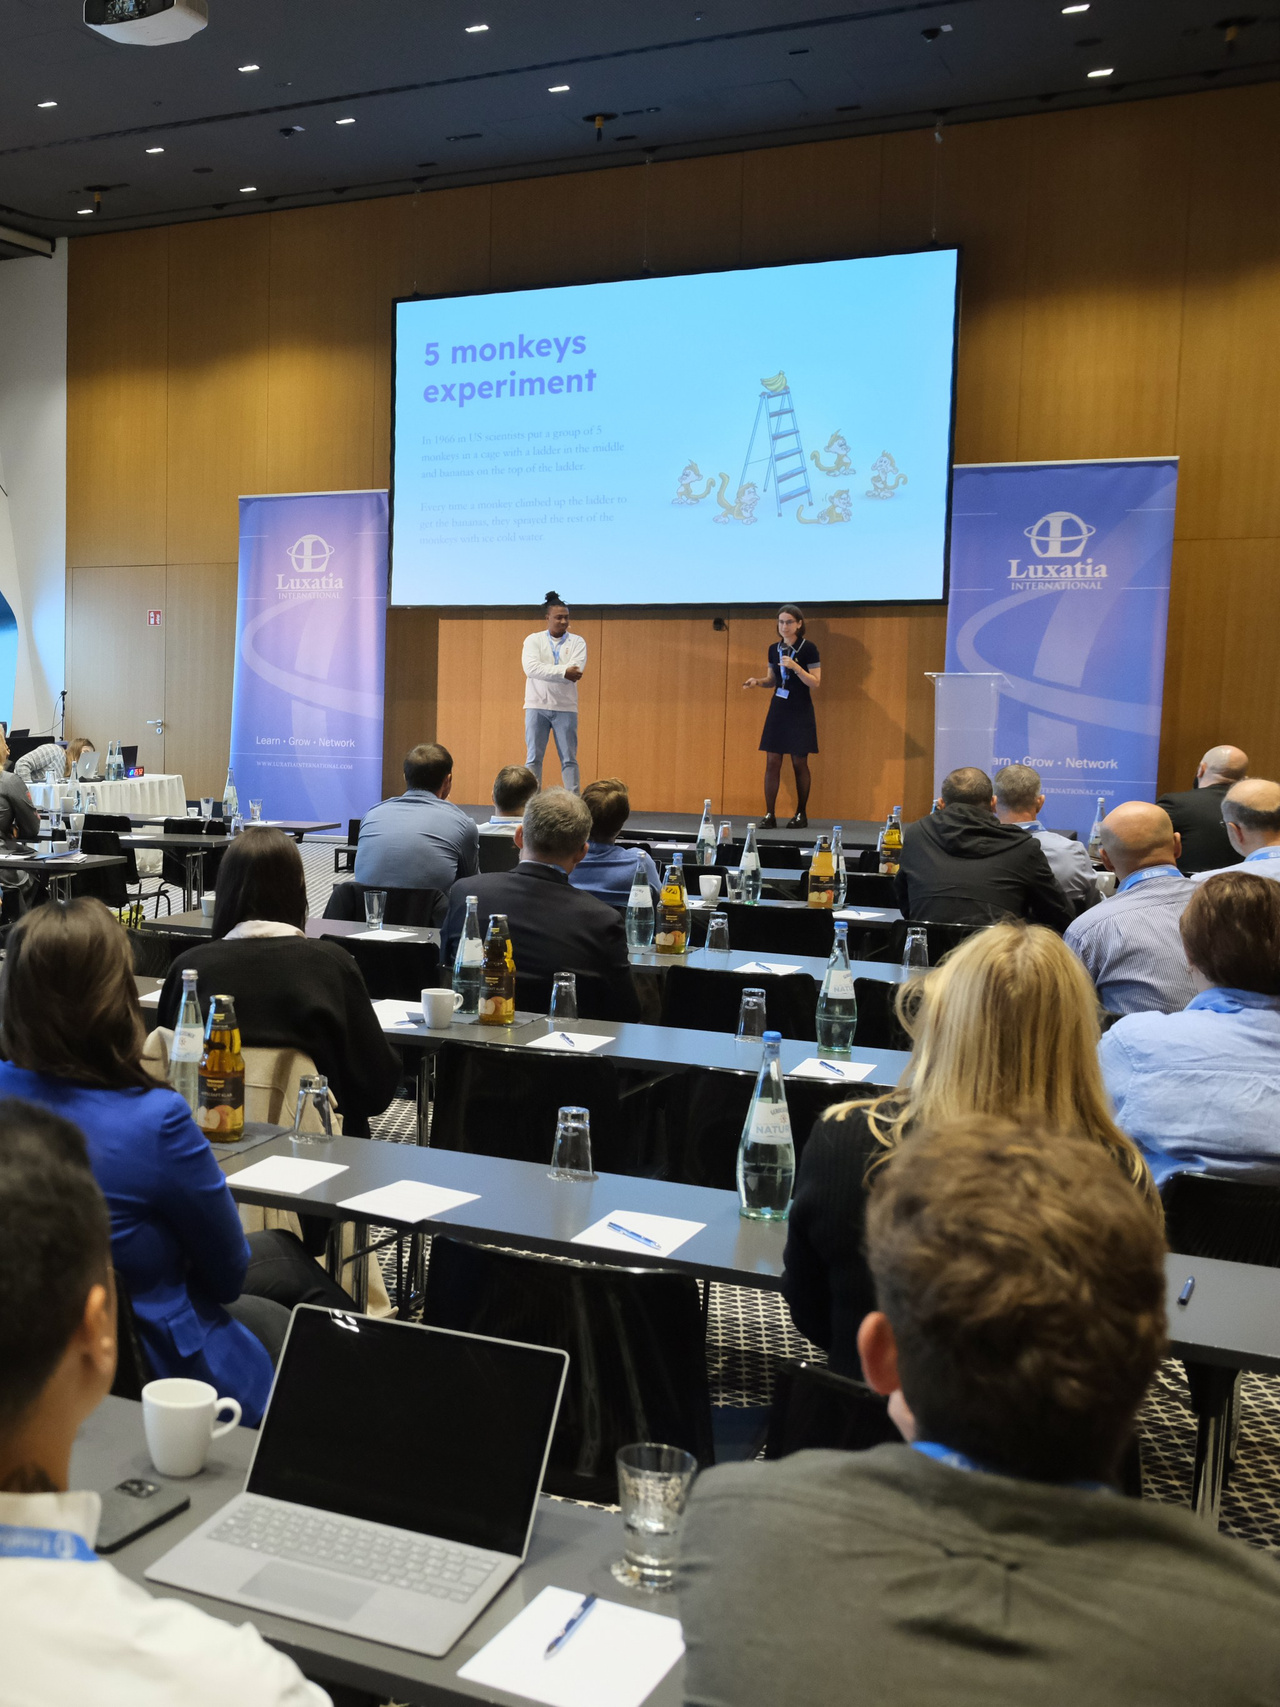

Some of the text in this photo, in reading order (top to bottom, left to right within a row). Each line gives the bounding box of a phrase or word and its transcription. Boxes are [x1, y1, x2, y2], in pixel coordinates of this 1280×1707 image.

[424, 334, 587, 366] 5 monkeys
[423, 369, 597, 408] experiment
[422, 436, 432, 445] In
[435, 434, 456, 444] 1966
[457, 435, 467, 443] in
[469, 433, 483, 442] US
[484, 431, 525, 441] scientists
[527, 430, 543, 442] put
[552, 430, 581, 440] group
[583, 426, 594, 436] of
[421, 452, 460, 463] monkeys
[462, 451, 471, 459] in
[480, 451, 500, 461] cage
[503, 447, 523, 457] with
[532, 445, 561, 456] ladder
[563, 445, 573, 454] in
[575, 443, 590, 453] the
[592, 442, 625, 452] middle
[421, 468, 437, 478] and
[439, 467, 474, 477] bananas
[491, 465, 506, 475] the
[508, 465, 524, 477] top
[525, 464, 536, 473] of
[538, 463, 553, 473] the
[1007, 558, 1108, 579] Luxatia
[276, 573, 344, 590] Luxatia
[1011, 581, 1103, 590] INTERNATIONAL
[278, 592, 340, 600] INTERNATIONAL
[256, 735, 356, 747] Learn Grow Network
[993, 756, 1119, 769] arn Grow Network
